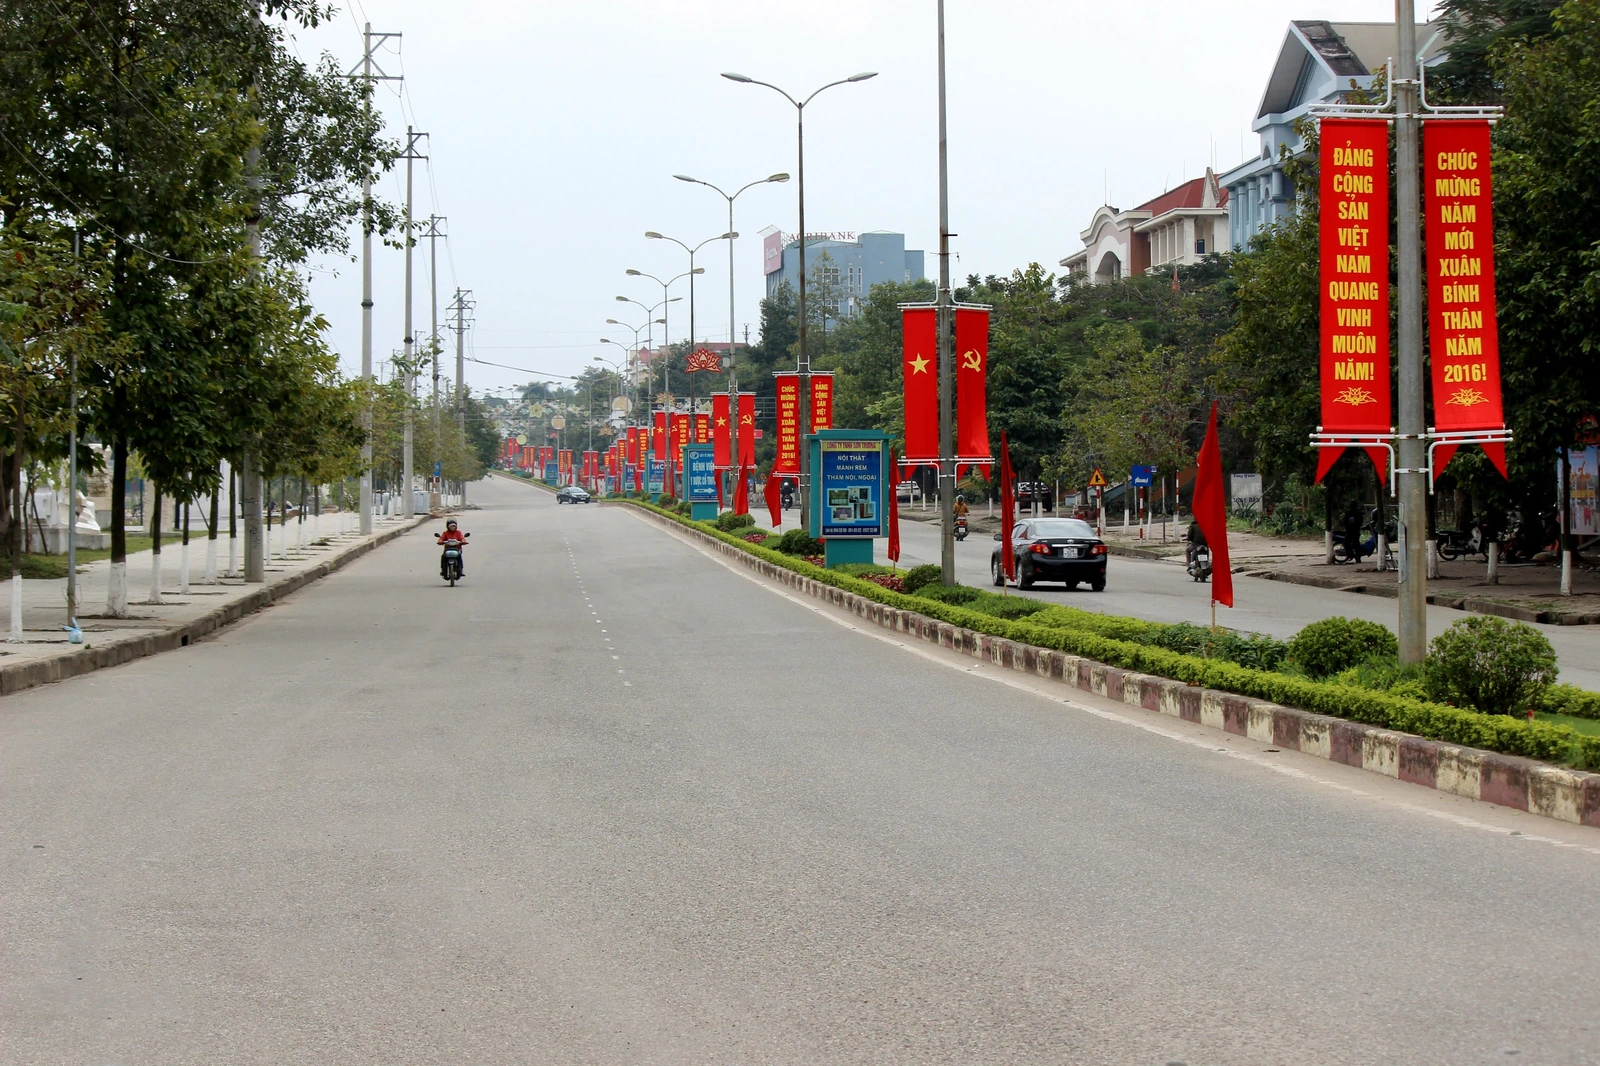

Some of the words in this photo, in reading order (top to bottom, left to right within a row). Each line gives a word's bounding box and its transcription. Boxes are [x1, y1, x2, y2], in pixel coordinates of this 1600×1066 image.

[1333, 140, 1374, 167] ĐẢNG
[1437, 148, 1478, 171] CHÚC
[1333, 170, 1373, 197] CỘNG
[1435, 174, 1481, 197] MỪNG
[1338, 194, 1368, 220] SẢN
[1441, 202, 1477, 224] NĂM
[1338, 225, 1369, 251] VIỆT
[1444, 227, 1475, 250] MỚI
[1337, 255, 1371, 274] NAM
[1439, 254, 1481, 277] XUÂN
[1329, 280, 1379, 301] QUANG
[1442, 281, 1480, 304] BÍNH
[1337, 308, 1372, 327] VINH
[1442, 308, 1483, 330] THÂN
[1332, 332, 1377, 354] MUÔN
[1445, 334, 1483, 357] NĂM
[1334, 358, 1375, 381] NĂM!
[1443, 363, 1488, 383] 2016!
[781, 385, 795, 393] CHÚC
[781, 418, 796, 426] XUÂN
[706, 461, 714, 473] VIỆ
